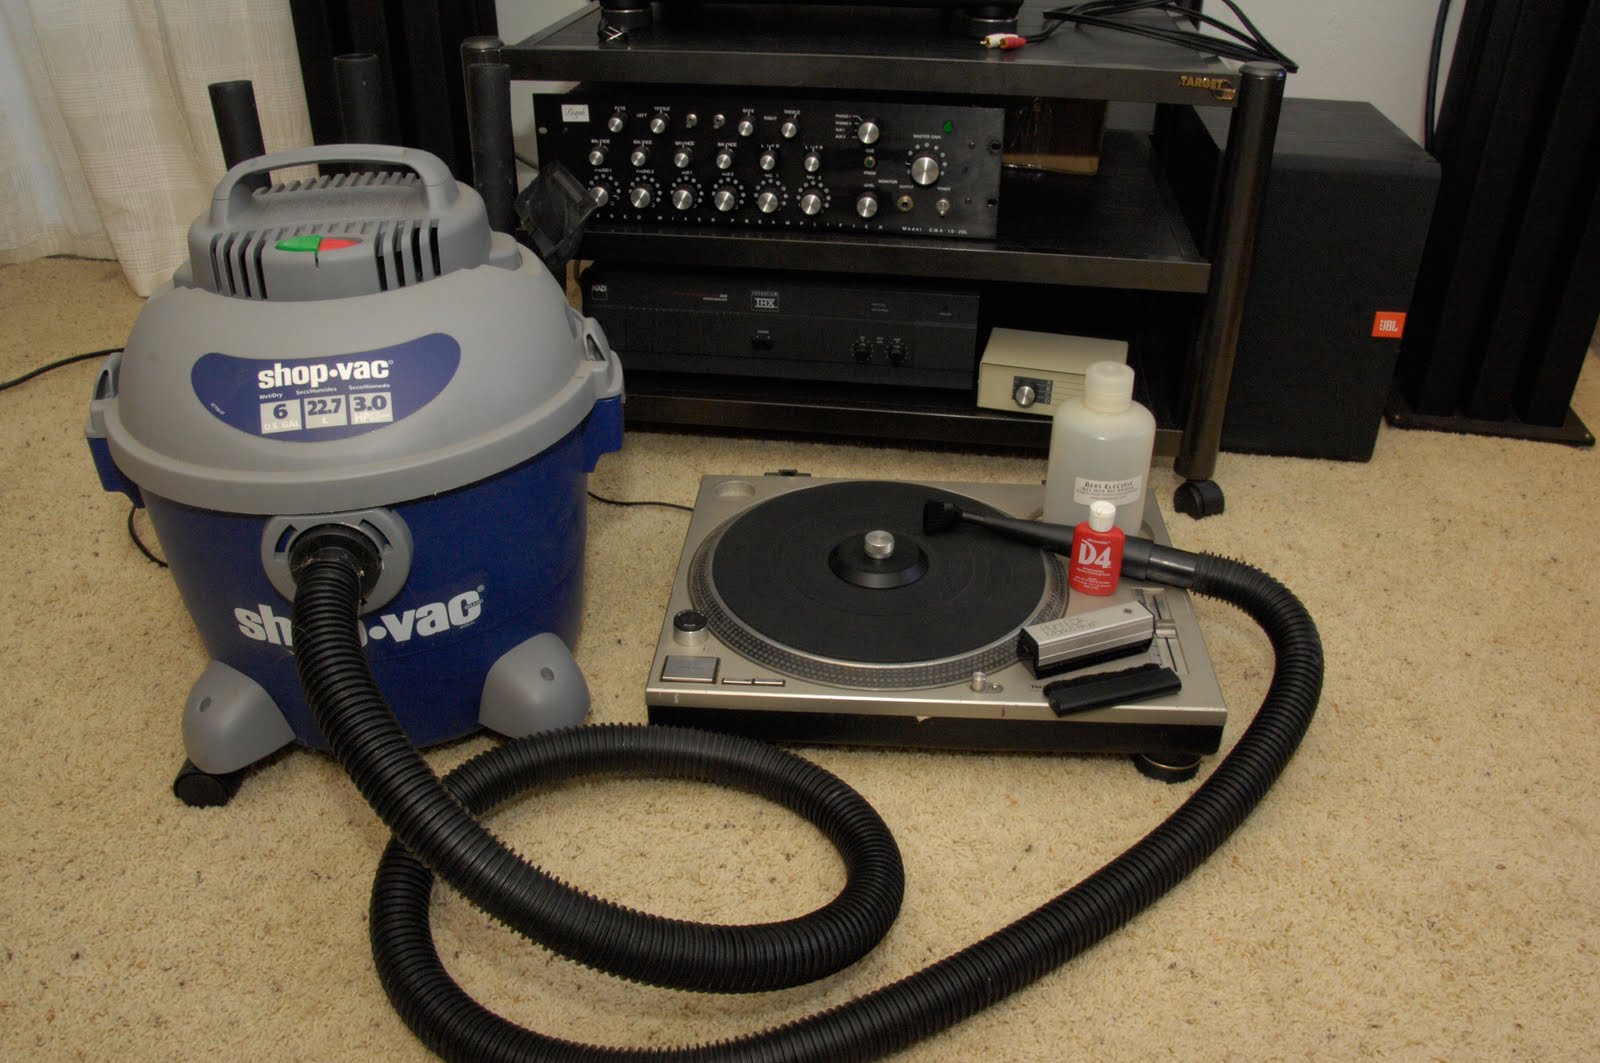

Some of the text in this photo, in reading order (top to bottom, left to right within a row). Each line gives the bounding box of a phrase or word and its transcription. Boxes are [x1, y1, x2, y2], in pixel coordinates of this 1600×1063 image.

[592, 284, 607, 292] NAD
[754, 297, 776, 309] THX
[1380, 320, 1399, 332] JBL
[259, 391, 284, 400] Wet/Dry
[273, 395, 388, 420] 6 22.7 3.0
[354, 412, 369, 423] HP
[1078, 539, 1112, 568] D4
